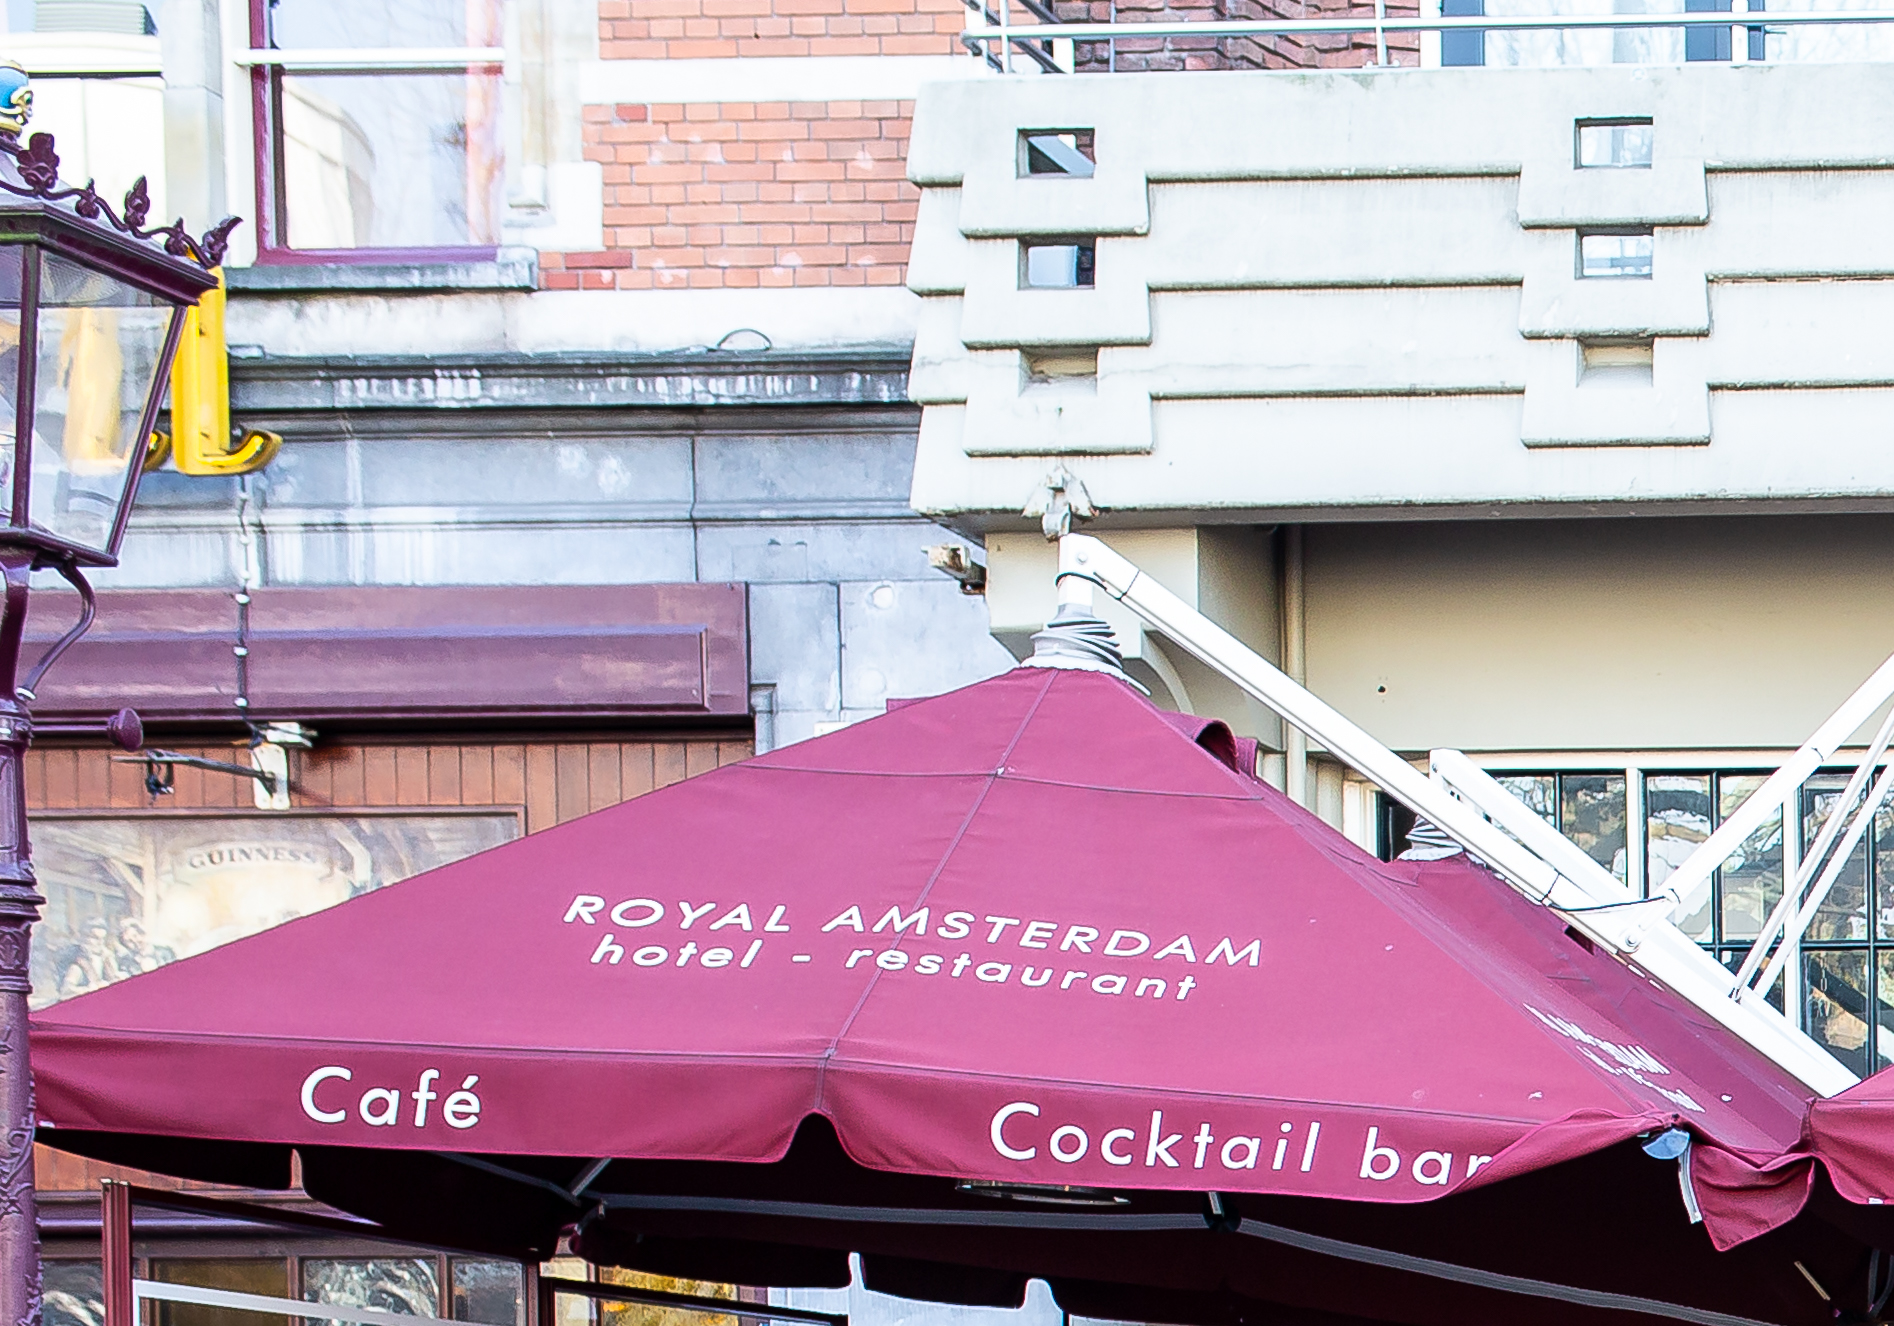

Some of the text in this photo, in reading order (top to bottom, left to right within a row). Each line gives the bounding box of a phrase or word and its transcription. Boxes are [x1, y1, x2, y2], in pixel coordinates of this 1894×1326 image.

[562, 894, 1262, 967] ROYAL AMSTERDAM
[589, 933, 764, 970] hotel
[844, 948, 1198, 1002] restaurant
[300, 1065, 482, 1129] Café
[990, 1101, 1321, 1173] Cocktail
